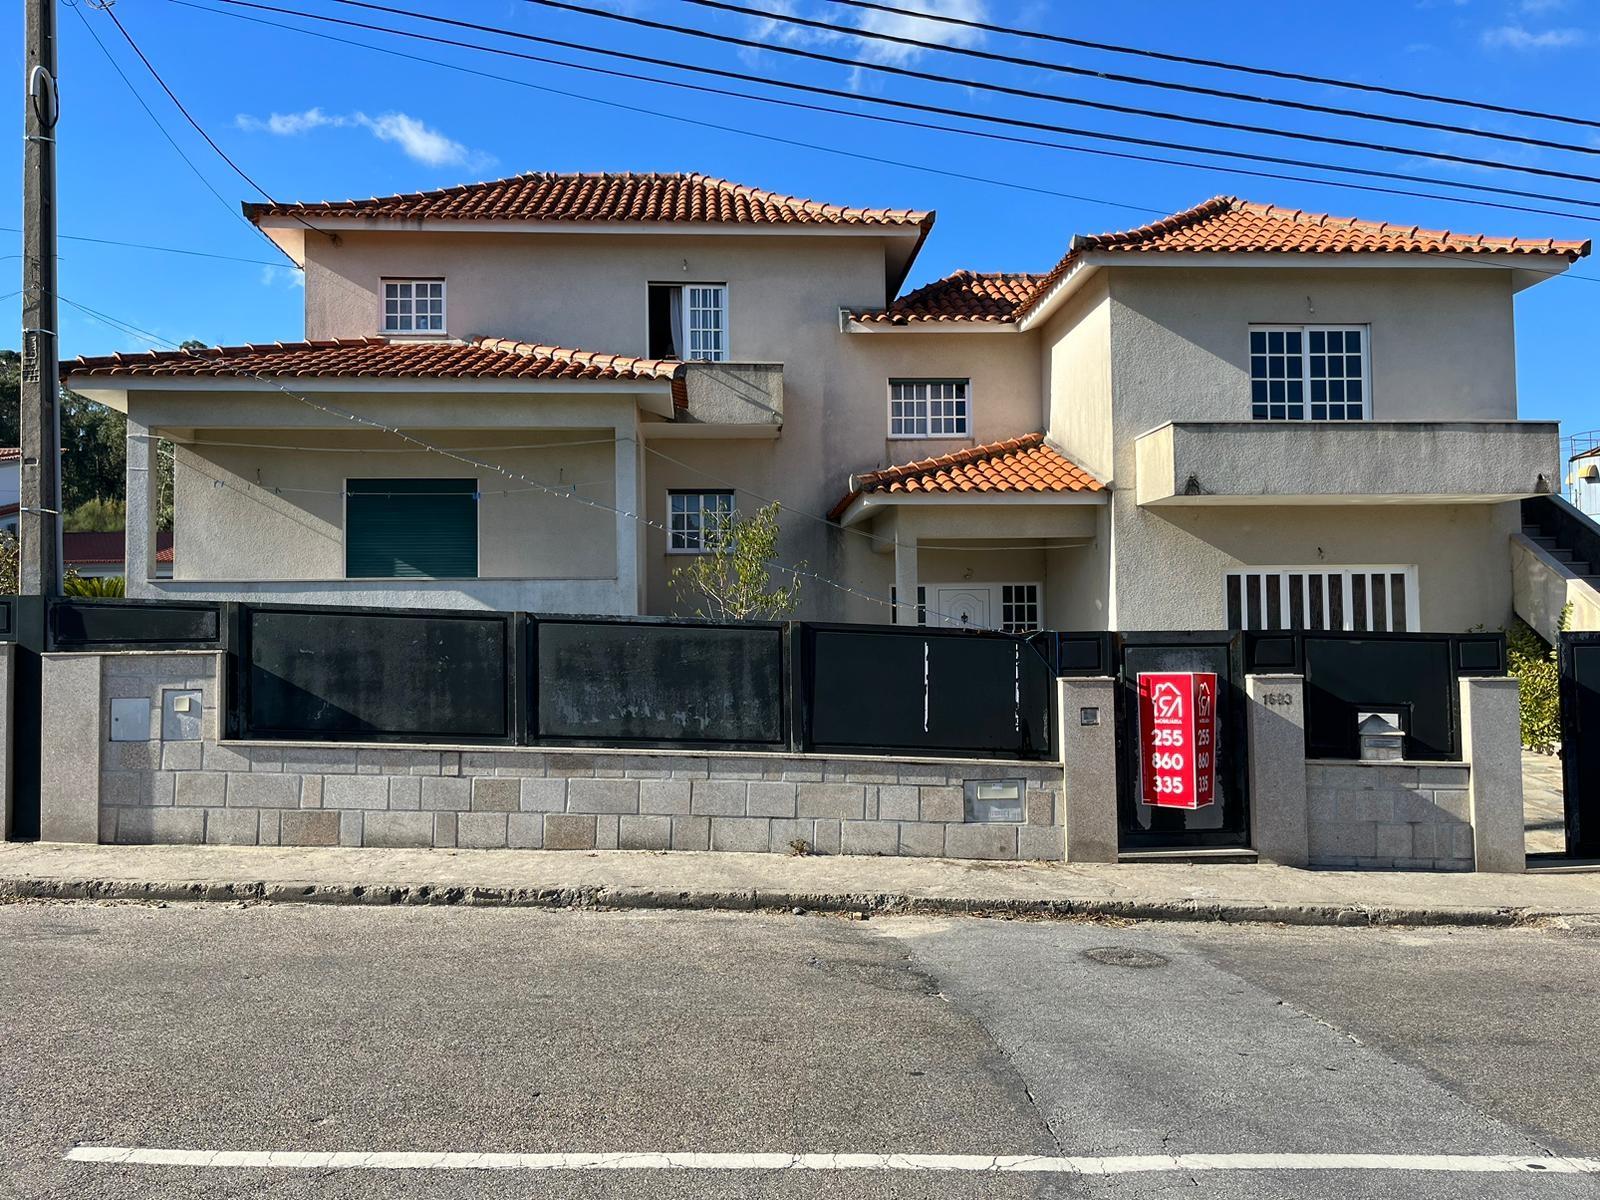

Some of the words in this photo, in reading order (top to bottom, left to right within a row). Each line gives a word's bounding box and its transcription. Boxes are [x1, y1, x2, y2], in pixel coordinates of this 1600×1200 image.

[1151, 728, 1184, 747] 255
[1198, 728, 1210, 746] 255
[1151, 752, 1184, 771] 860
[1198, 752, 1210, 769] 860
[1152, 775, 1184, 795] 335
[1198, 775, 1209, 793] 335
